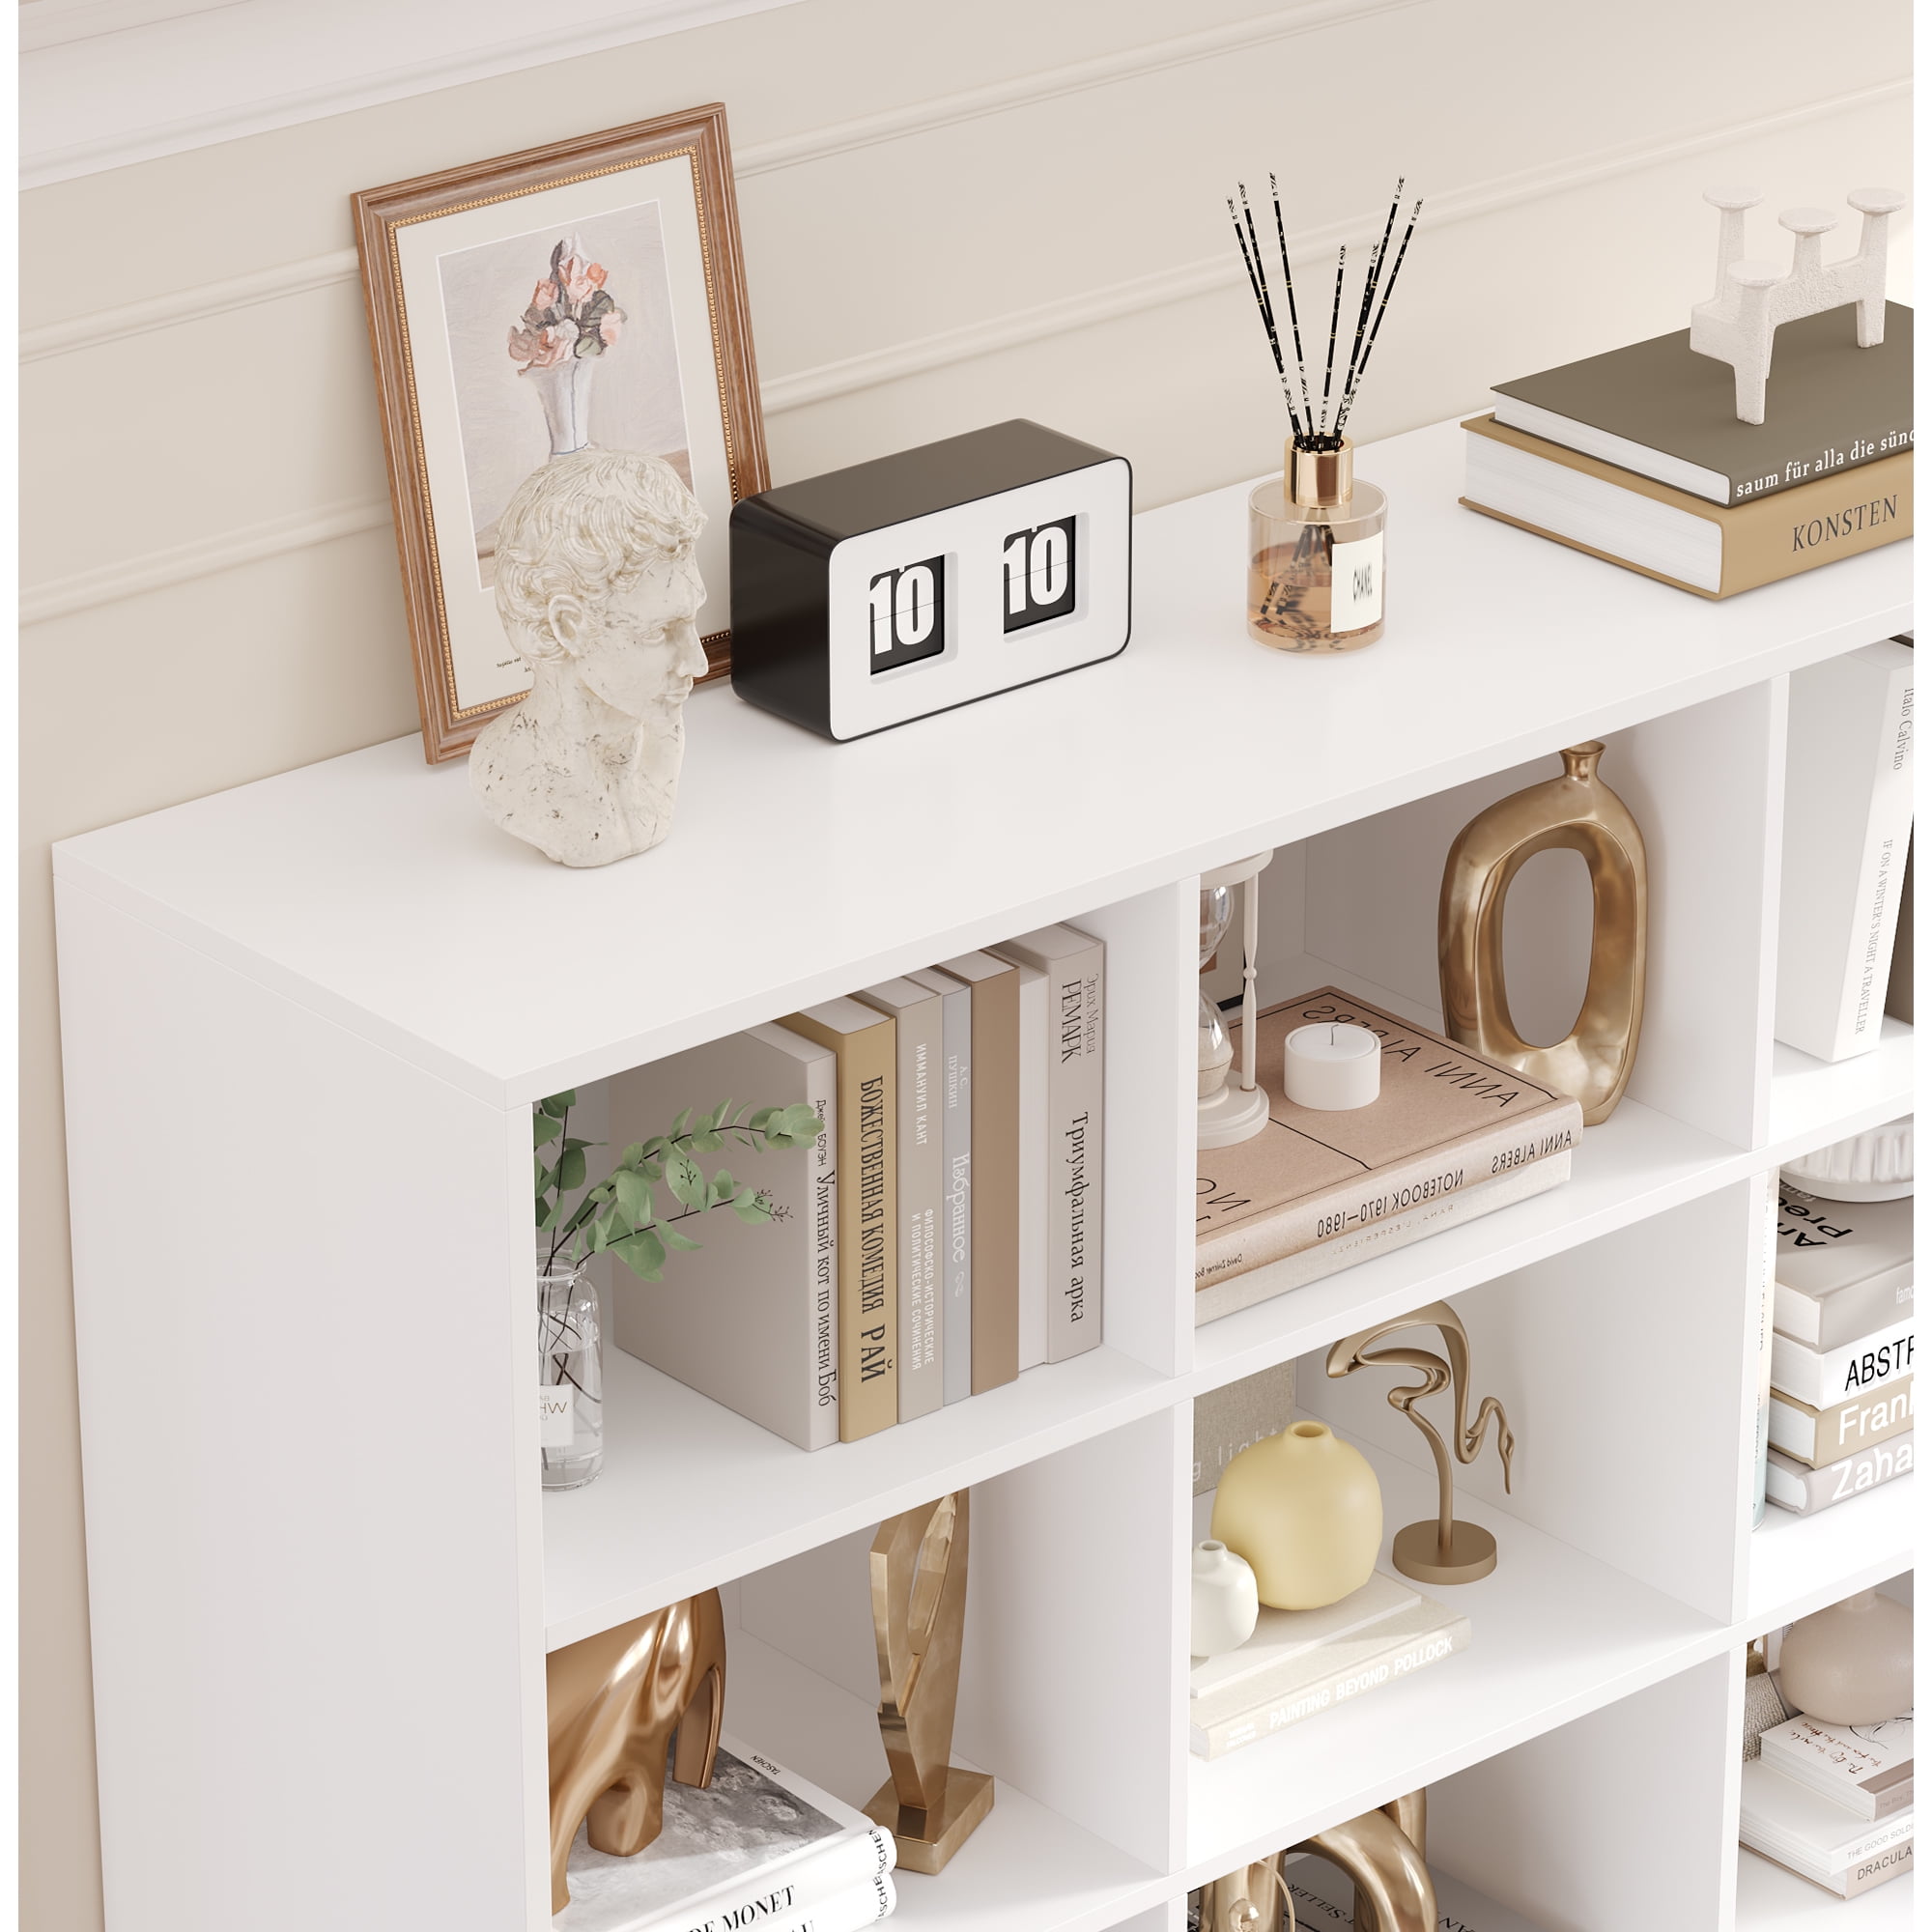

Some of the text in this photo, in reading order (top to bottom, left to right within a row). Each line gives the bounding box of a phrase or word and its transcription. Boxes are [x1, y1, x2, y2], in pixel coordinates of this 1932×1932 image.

[1737, 473, 1778, 497] saum
[1785, 462, 1809, 482] für
[1815, 448, 1844, 471] alla
[1851, 440, 1875, 461] die
[1792, 495, 1897, 553] KONSTEN
[1004, 526, 1068, 614] 10
[870, 566, 934, 654] 10
[1893, 720, 1912, 770] Calvino
[1881, 851, 1891, 867] ON
[1865, 930, 1879, 963] NIGHT
[1062, 980, 1081, 1064] РЕМАРК
[1083, 1009, 1098, 1054] Мария
[1855, 975, 1872, 1035] TRAVELLER
[916, 1043, 927, 1145] ИММАНУИЛ КАНТ
[949, 1055, 957, 1109] ПУШКИН
[816, 1170, 836, 1253] Уличный
[858, 1075, 893, 1383] БОЖЕСТВЕННАЯ КОМЕДИЯ РАЙ
[946, 1151, 970, 1263] Избранное
[1065, 1111, 1090, 1322] Триумфальная арка
[818, 1256, 830, 1284] кот
[912, 1213, 922, 1371] И ПОЛИТИЧЕСКИЕ СОЧИНЕНИЯ
[924, 1208, 934, 1365] ФИЛОСОФСКО-ИСТОРИЧЕСКИЕ
[818, 1289, 830, 1312] по
[818, 1314, 830, 1370] имени
[818, 1369, 837, 1406] Боб
[1832, 1443, 1914, 1501] Zaha
[1269, 1636, 1453, 1729] PAINTING BEYOND POLLOCK
[750, 1755, 781, 1775] TASCHEN
[1847, 1846, 1862, 1860] THE
[1864, 1834, 1888, 1851] GOOD
[1857, 1845, 1913, 1880] DRACULA
[722, 1885, 795, 1932] MONET
[1287, 1883, 1346, 1919] SELLER
